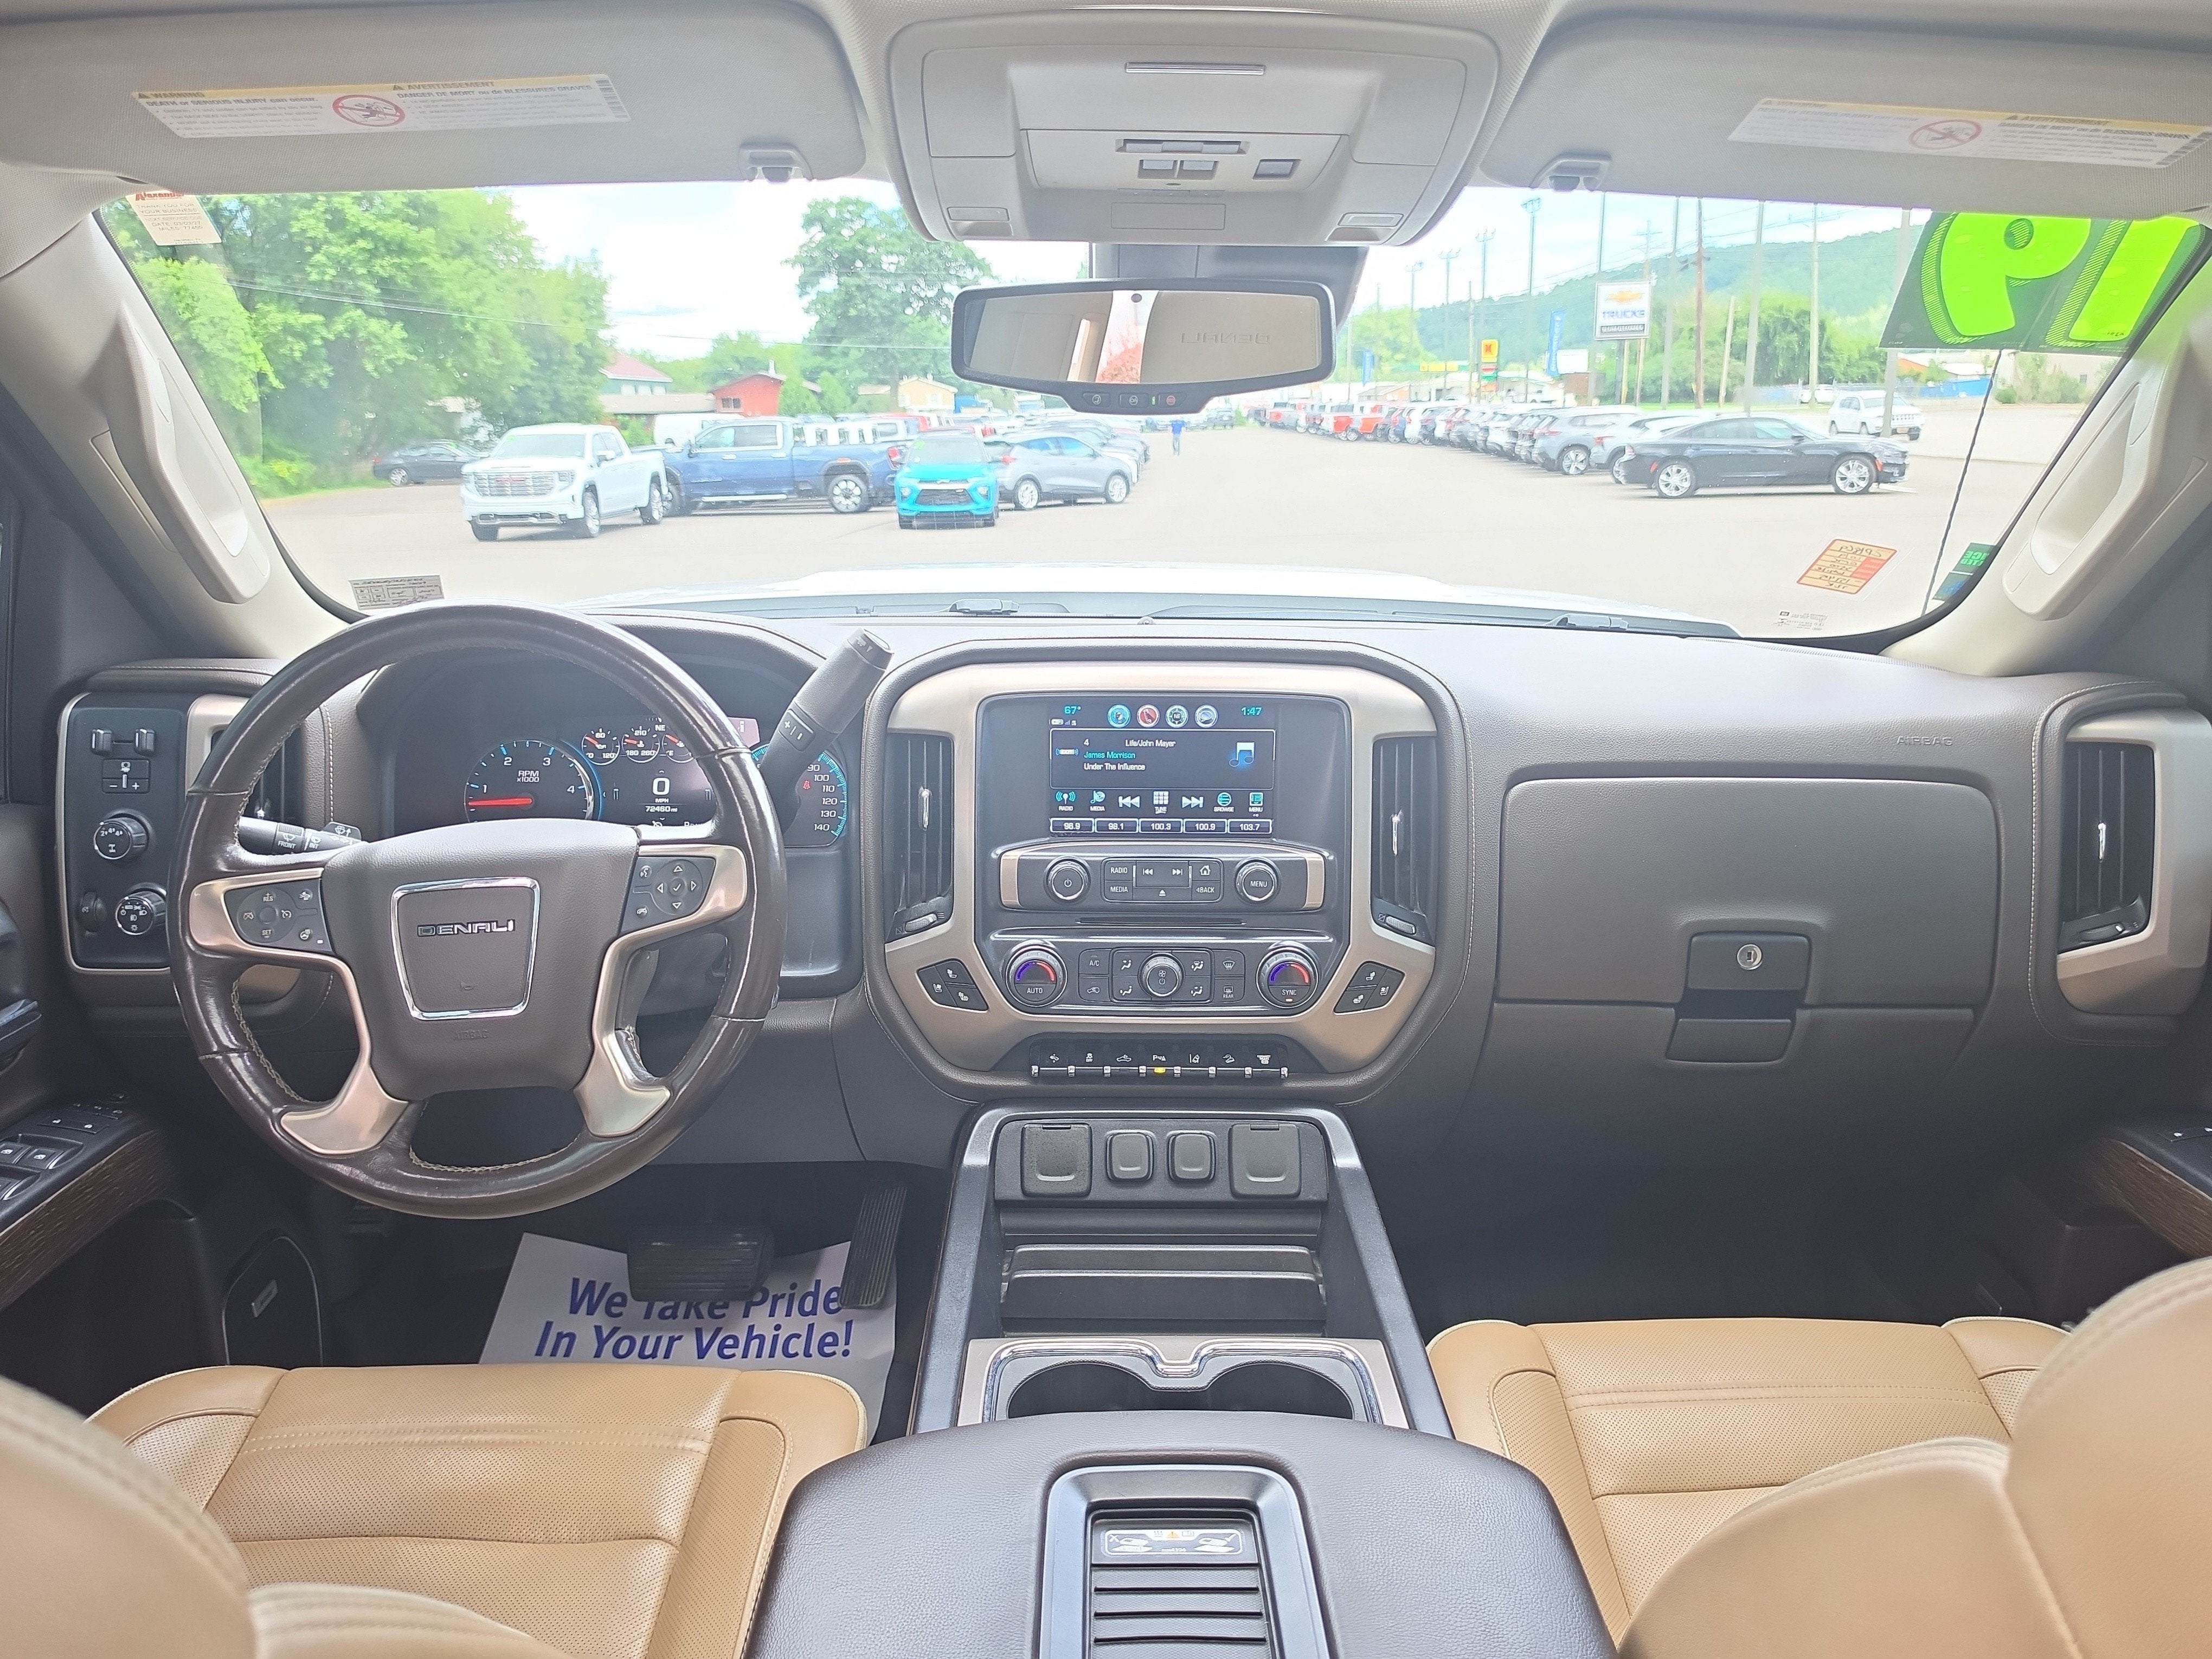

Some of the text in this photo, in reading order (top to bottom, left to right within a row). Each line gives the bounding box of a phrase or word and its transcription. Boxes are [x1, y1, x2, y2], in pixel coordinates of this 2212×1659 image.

[407, 81, 495, 90] AVERTISSEMENT
[1241, 706, 1263, 716] 1:47
[1155, 739, 1176, 748] Mayer
[504, 757, 512, 766] 2
[543, 757, 551, 766] 3
[652, 777, 670, 795] 0
[278, 840, 297, 850] FRONT
[417, 919, 516, 937] DENALI
[569, 1277, 627, 1318] We
[742, 1279, 842, 1319] Pride
[535, 1320, 854, 1360] In Your Vehicle!
